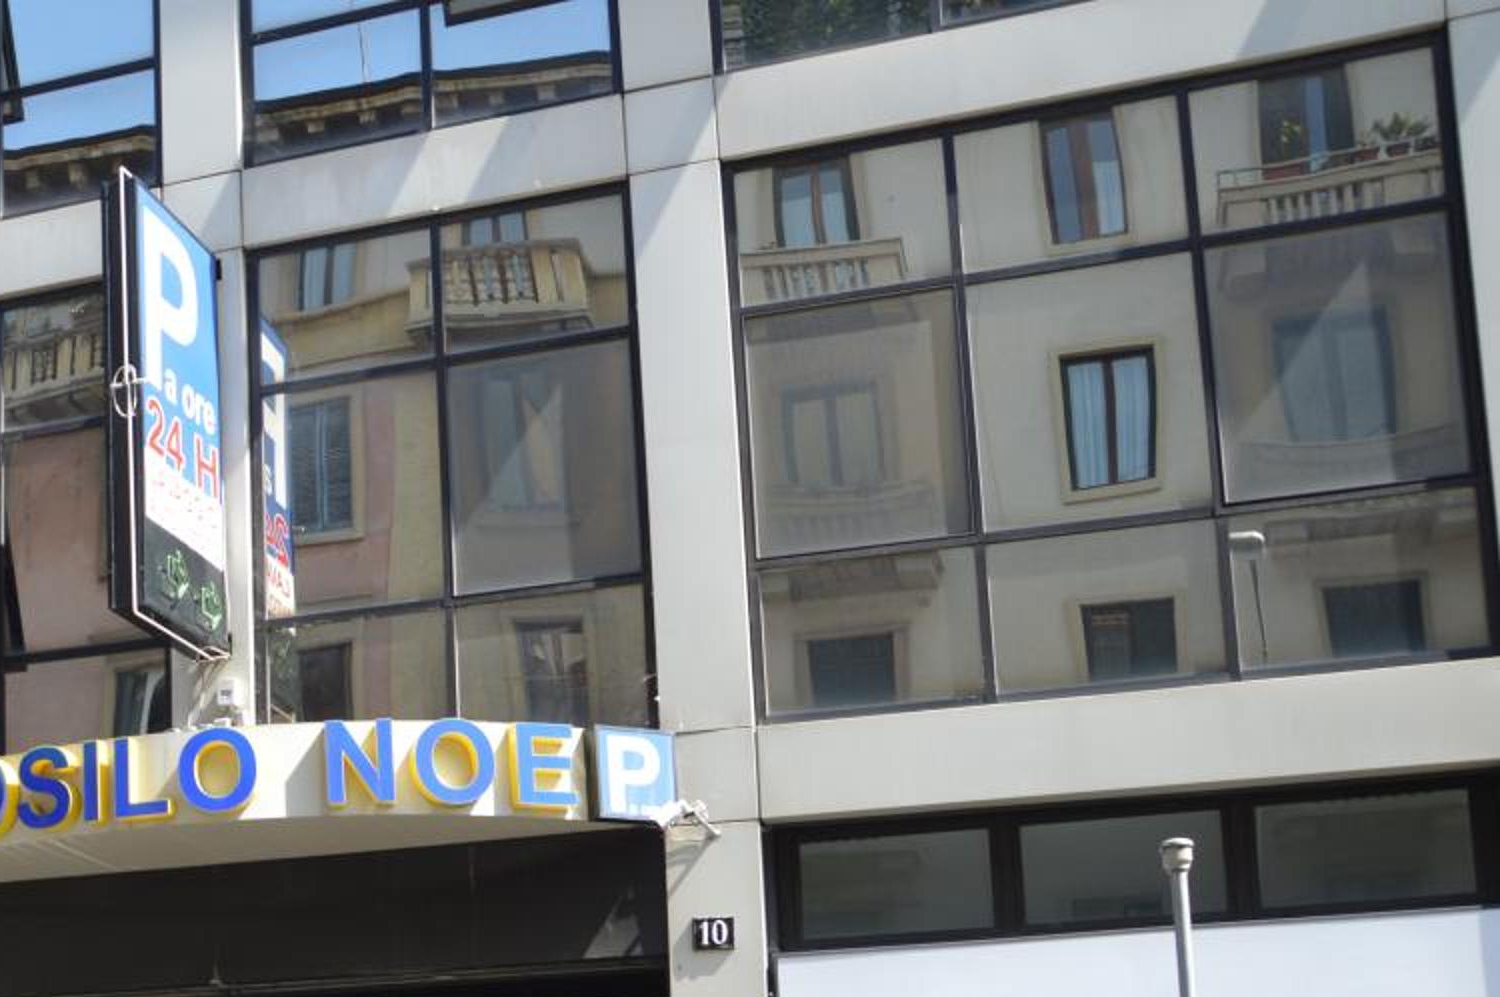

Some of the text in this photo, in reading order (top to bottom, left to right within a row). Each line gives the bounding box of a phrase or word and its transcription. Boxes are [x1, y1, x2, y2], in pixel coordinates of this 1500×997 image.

[142, 204, 199, 391] P
[164, 368, 216, 435] a ore
[146, 396, 219, 499] 24 H
[323, 717, 581, 808] NOE
[607, 734, 662, 815] P
[698, 919, 730, 946] 10
